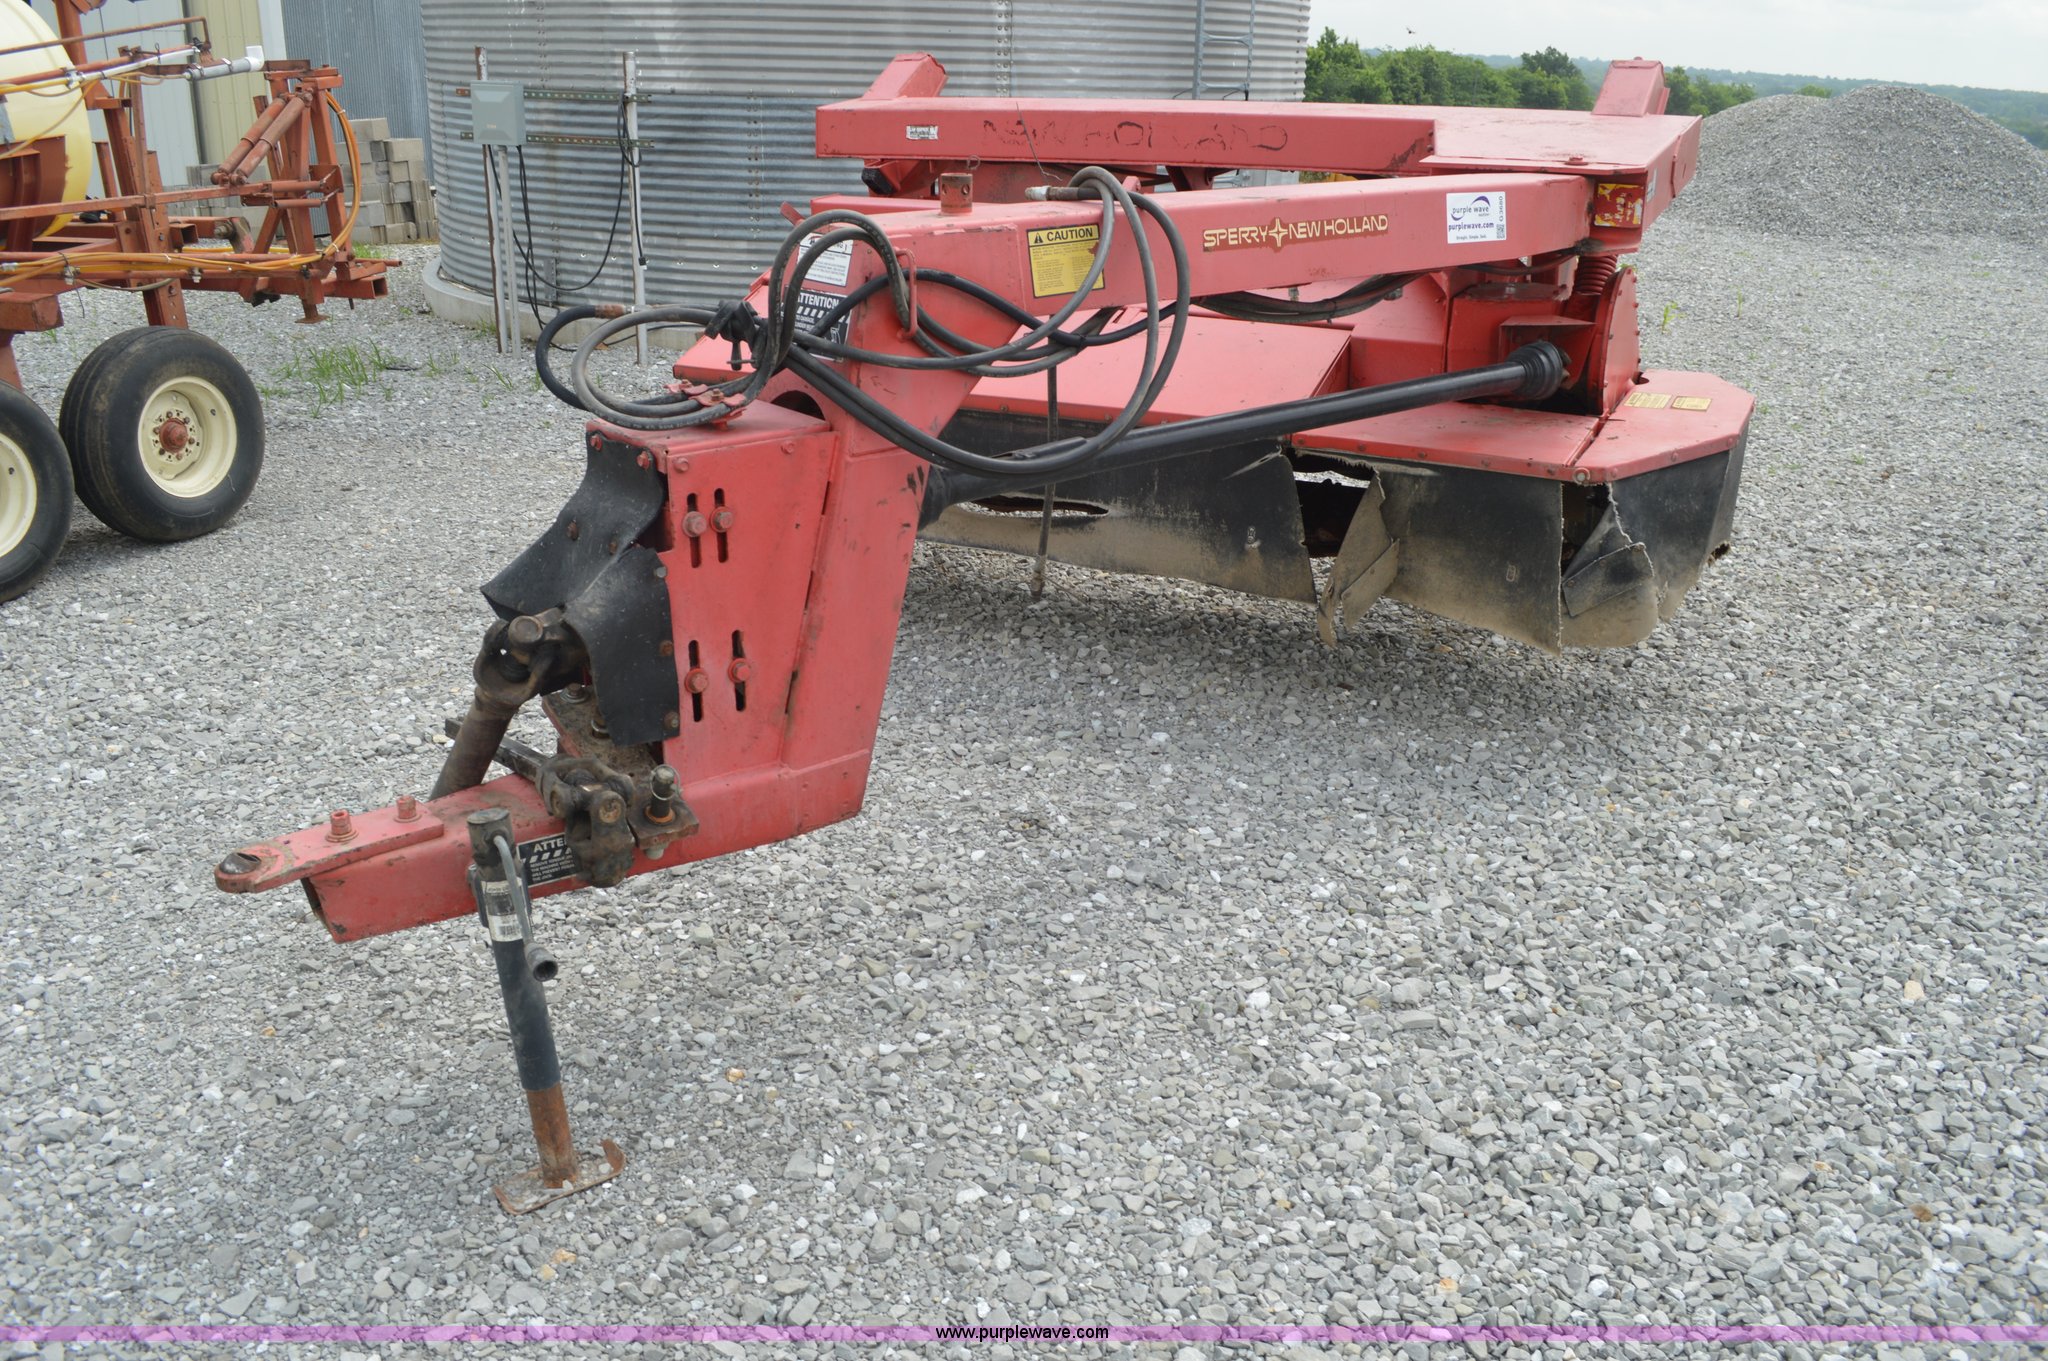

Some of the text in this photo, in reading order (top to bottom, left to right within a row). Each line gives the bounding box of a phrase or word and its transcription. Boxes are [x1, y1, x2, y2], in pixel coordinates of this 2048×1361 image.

[1452, 206, 1472, 214] purple
[1046, 227, 1093, 241] CAUTION
[1203, 214, 1389, 248] SPERRY NEW HOLLAND
[1448, 222, 1494, 232] purplewave.com
[798, 292, 840, 310] TTENTION
[533, 837, 566, 853] ATTE
